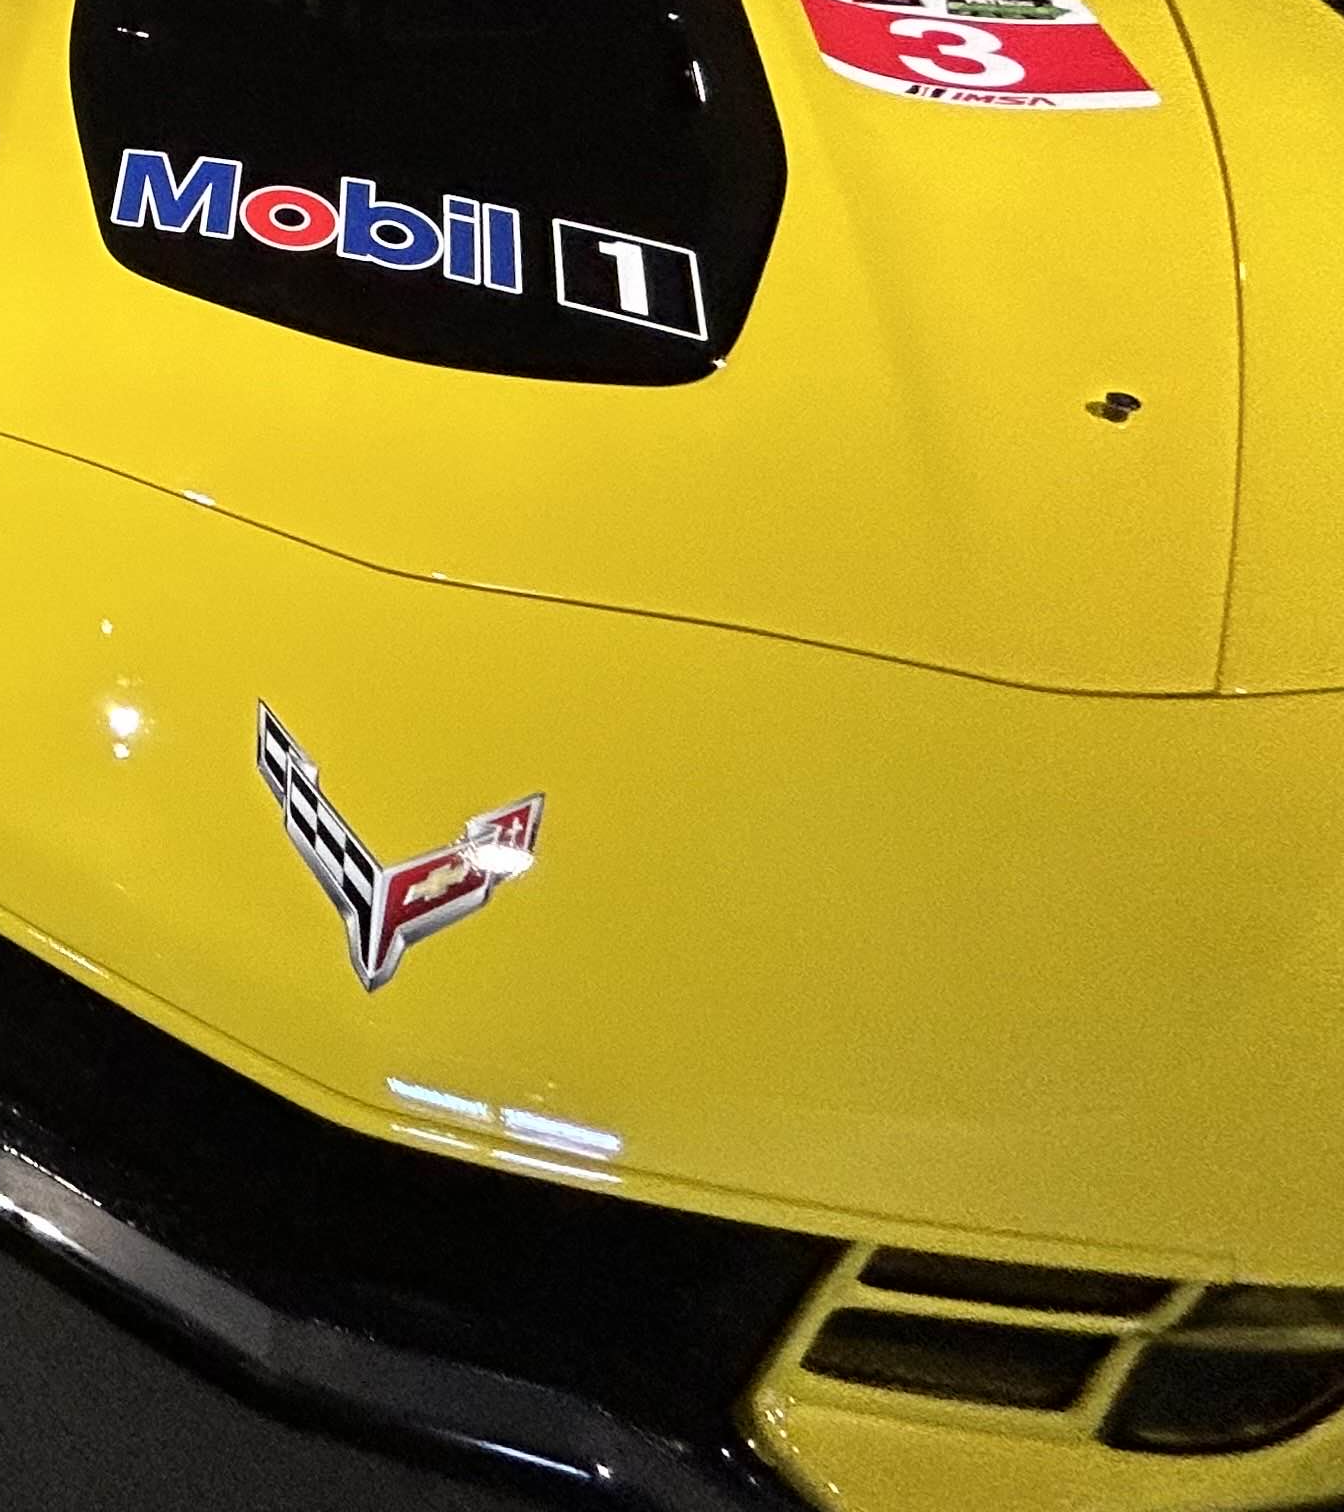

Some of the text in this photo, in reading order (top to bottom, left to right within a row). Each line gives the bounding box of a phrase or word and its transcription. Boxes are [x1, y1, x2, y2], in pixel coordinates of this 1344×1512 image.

[888, 17, 1026, 88] 3
[951, 92, 1057, 107] IMSA
[110, 148, 524, 295] Mobil
